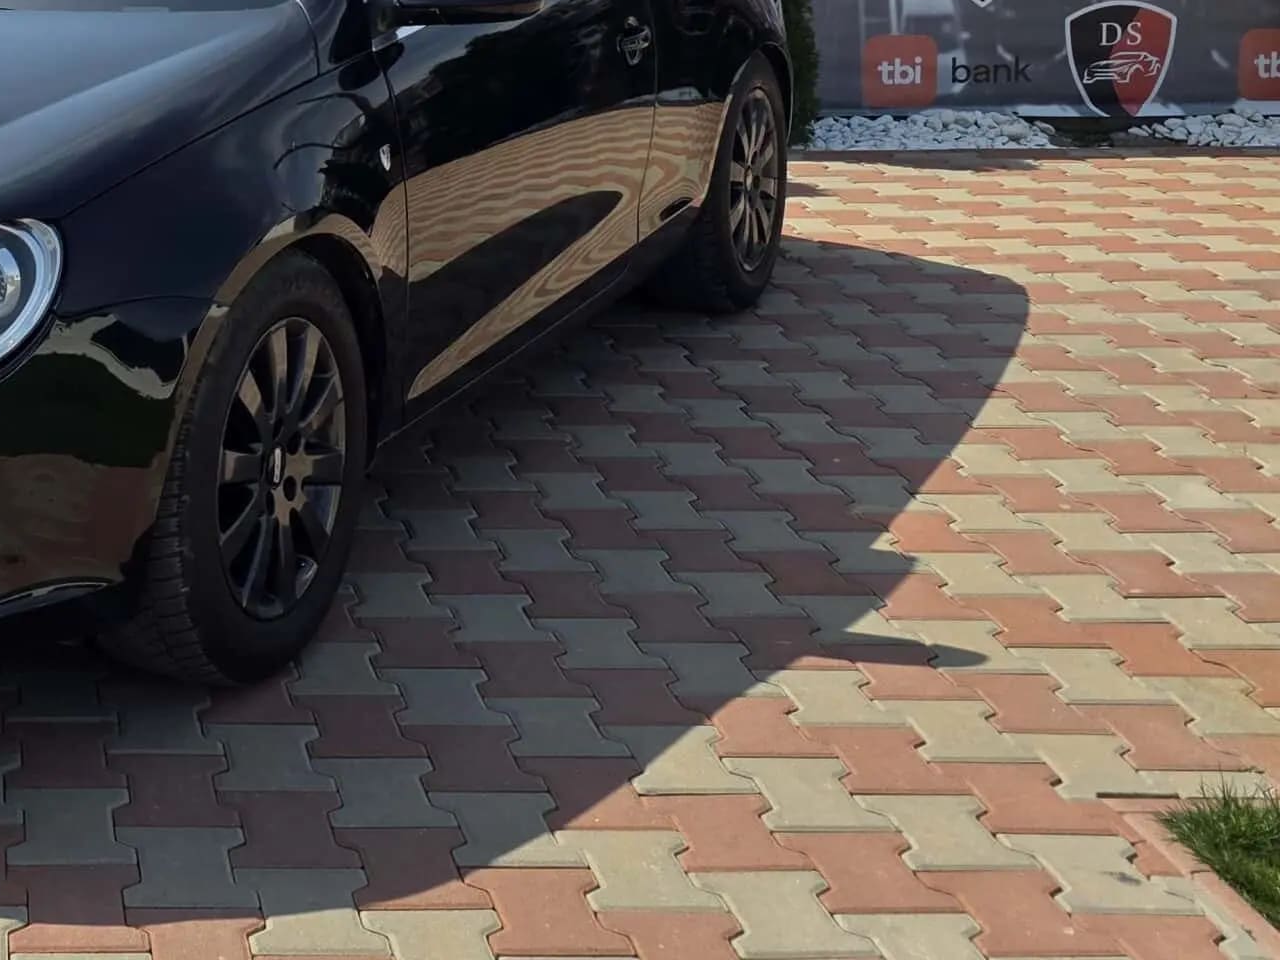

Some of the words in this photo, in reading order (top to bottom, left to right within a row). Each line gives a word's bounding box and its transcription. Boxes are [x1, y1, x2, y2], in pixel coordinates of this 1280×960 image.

[1099, 22, 1143, 46] DS
[877, 57, 923, 86] tbi
[950, 56, 1033, 85] bank
